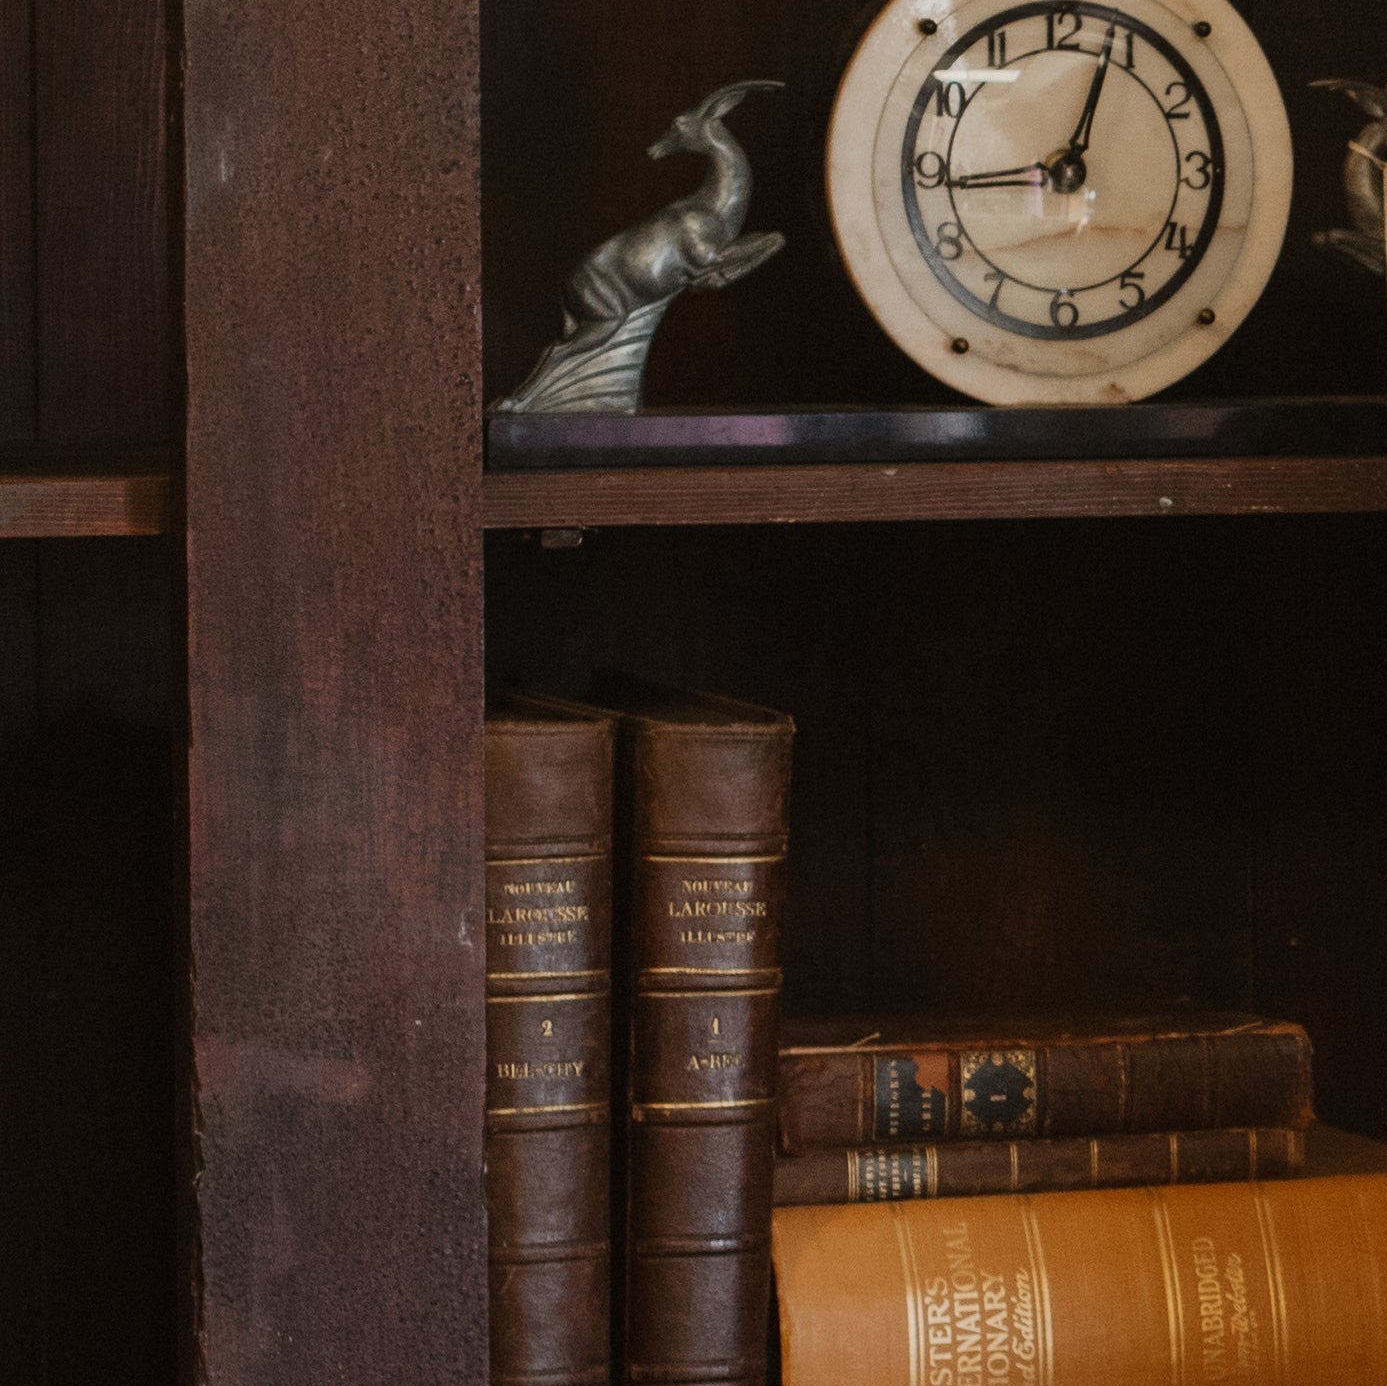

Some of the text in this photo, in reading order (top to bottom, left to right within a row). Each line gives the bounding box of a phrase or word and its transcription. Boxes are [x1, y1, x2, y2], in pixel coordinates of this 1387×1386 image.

[988, 31, 1007, 67] 11
[1045, 13, 1083, 51] 12
[1125, 32, 1135, 69] 1
[934, 80, 966, 118] 10
[1165, 82, 1191, 119] 2
[915, 151, 946, 189] 9
[1184, 151, 1210, 190] 3
[936, 221, 963, 261] 8
[1164, 221, 1194, 259] 4
[984, 272, 1005, 312] 7
[1051, 290, 1079, 327] 6
[1119, 272, 1145, 312] 5
[504, 880, 575, 894] NOUVEAU
[682, 880, 753, 892] NOUVEAU
[488, 906, 589, 923] LAROUSSE
[669, 901, 767, 917] LAROUSSE
[541, 1019, 553, 1037] 2
[712, 1017, 720, 1036] 1
[1010, 1268, 1036, 1362] Edition
[1192, 1236, 1225, 1380] UNABRIDGED
